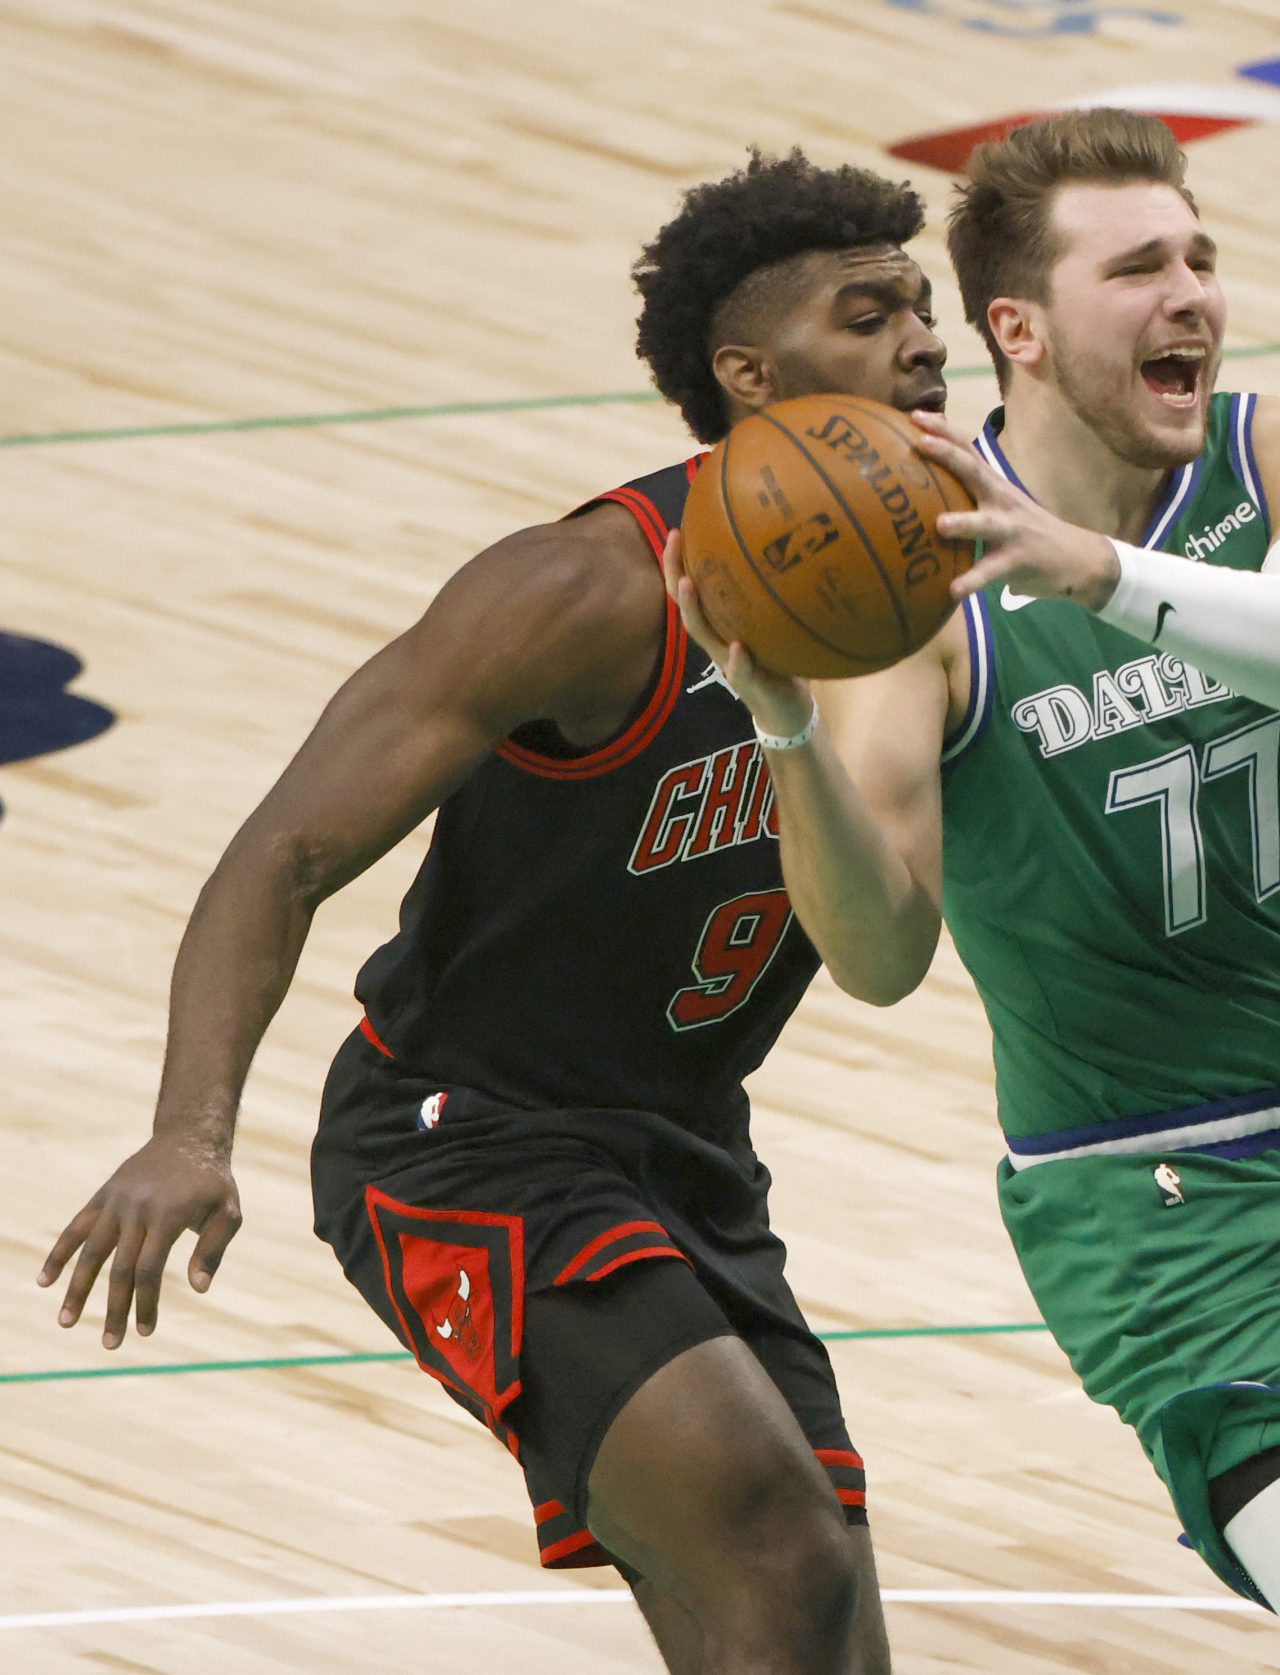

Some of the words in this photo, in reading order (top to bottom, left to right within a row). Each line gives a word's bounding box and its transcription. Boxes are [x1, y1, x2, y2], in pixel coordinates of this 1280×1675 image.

[806, 414, 941, 588] SPALDING
[1184, 501, 1257, 561] chime
[665, 887, 794, 1032] 9
